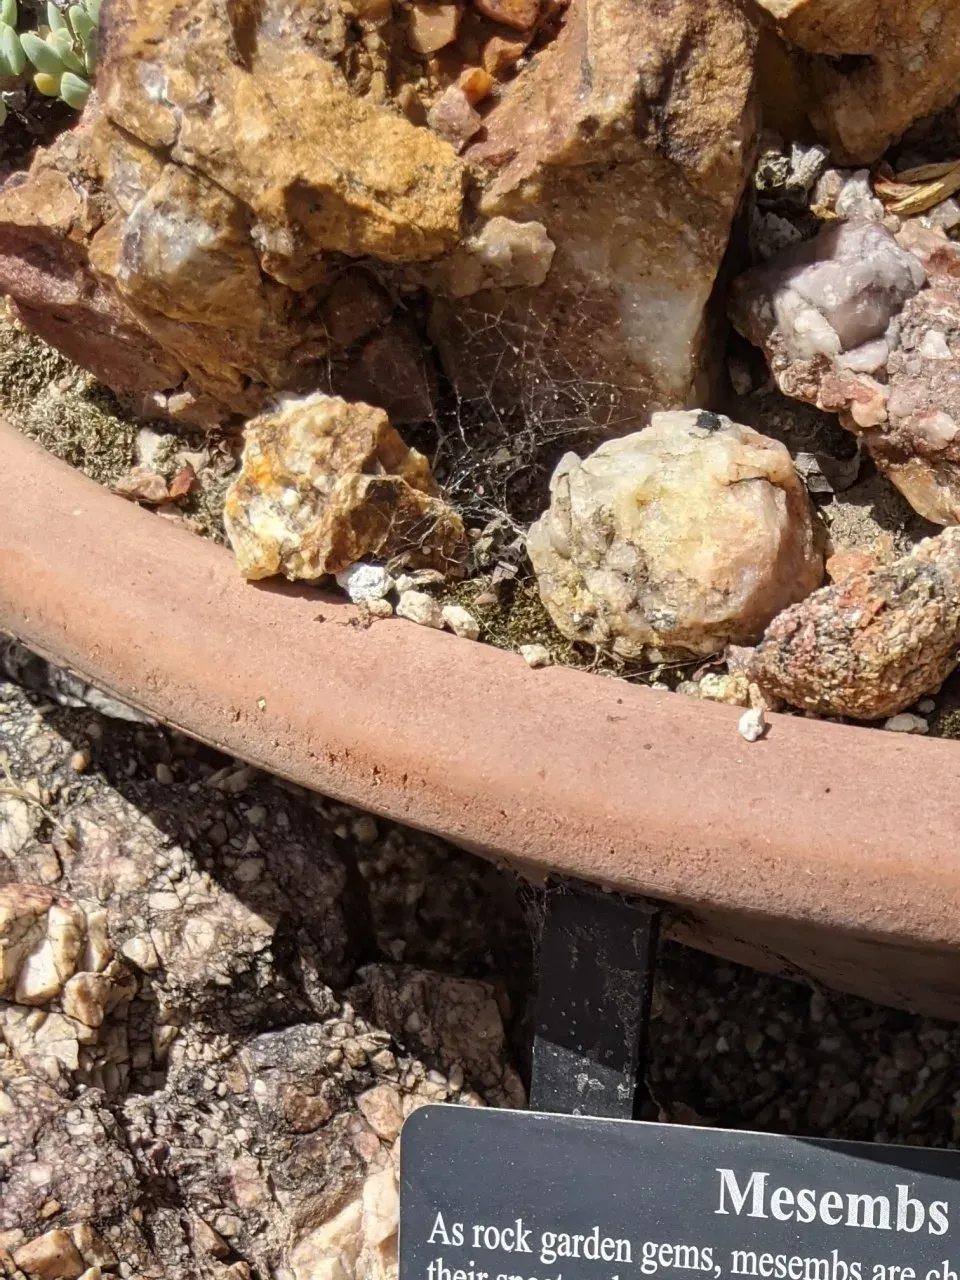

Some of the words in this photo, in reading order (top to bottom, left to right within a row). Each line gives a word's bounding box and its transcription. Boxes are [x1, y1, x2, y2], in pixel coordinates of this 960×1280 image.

[714, 1167, 949, 1236] Mesembs
[426, 1211, 465, 1247] As
[471, 1217, 534, 1253] rock
[539, 1225, 633, 1265] garden
[640, 1241, 722, 1279] gems,
